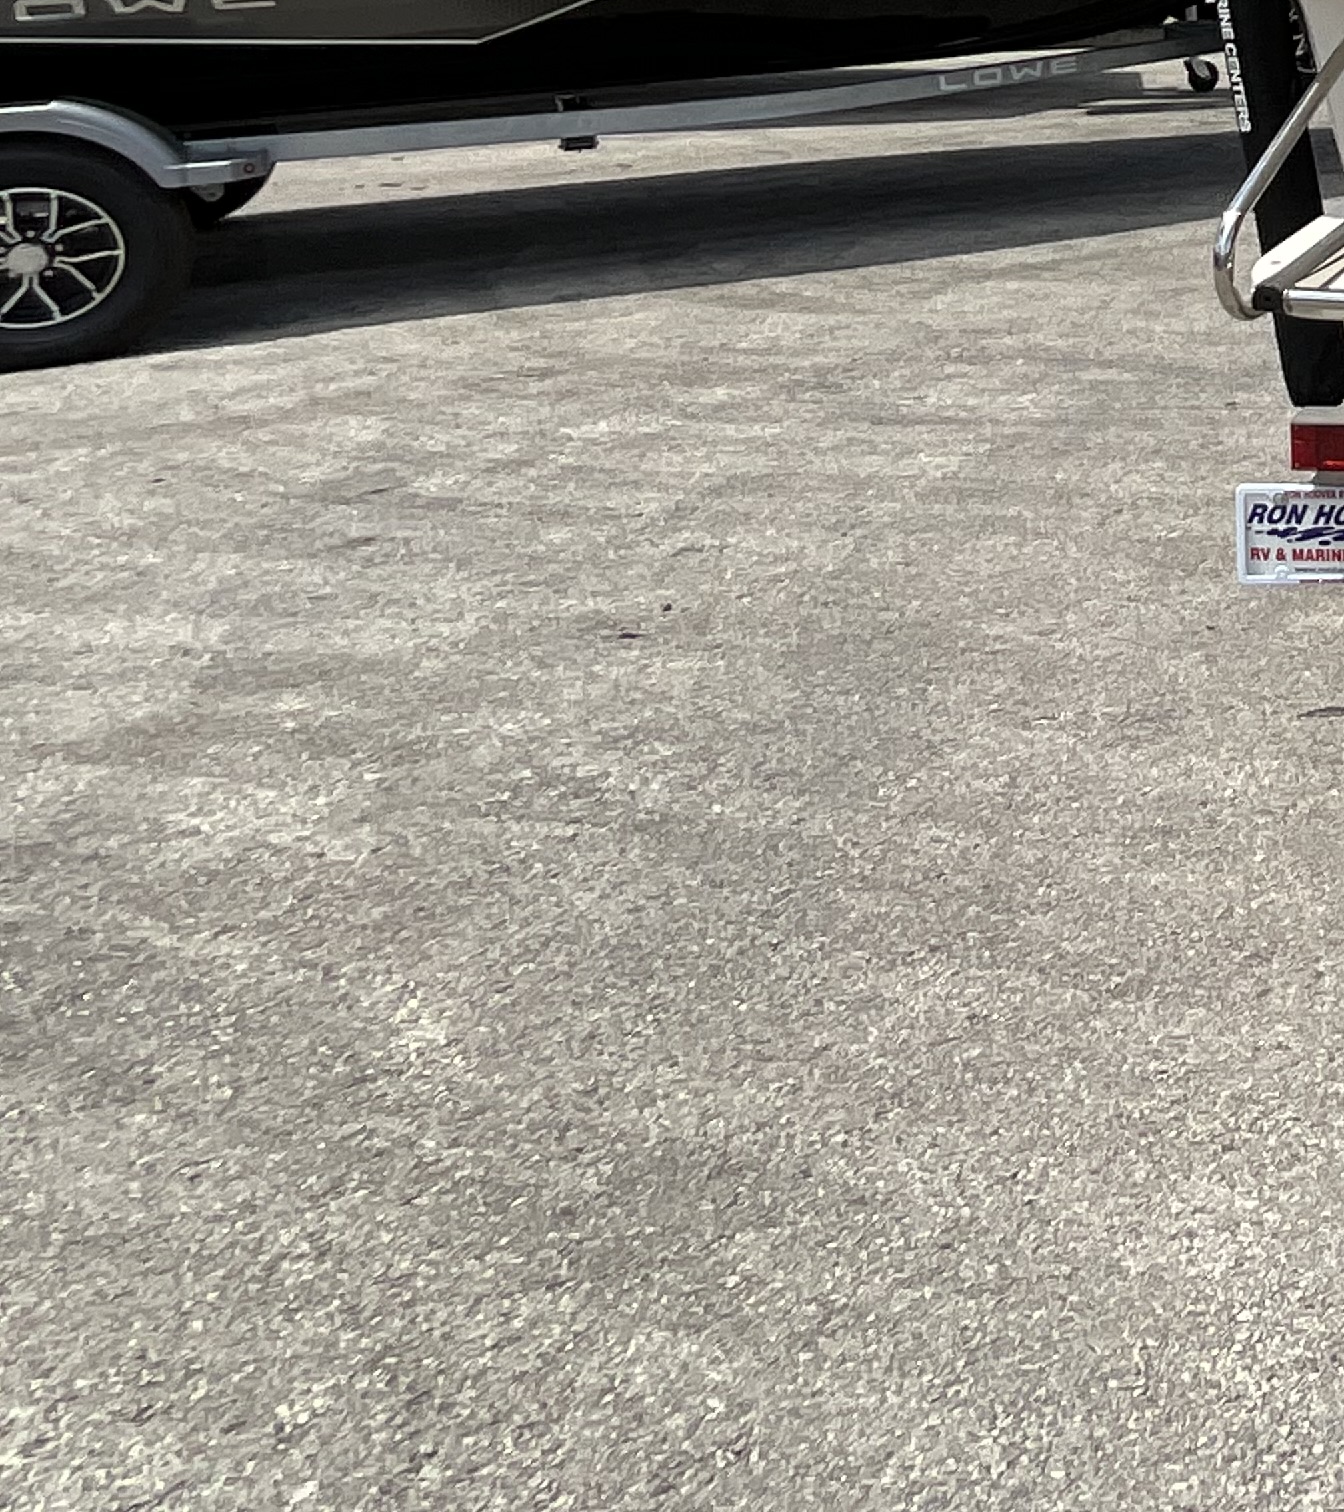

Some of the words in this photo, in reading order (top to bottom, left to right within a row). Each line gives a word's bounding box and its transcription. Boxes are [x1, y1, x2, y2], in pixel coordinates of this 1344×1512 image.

[938, 55, 1078, 91] LOWE
[1224, 42, 1253, 133] CENTERS
[1247, 503, 1309, 525] RON
[1250, 547, 1271, 561] RV
[1275, 547, 1287, 562] &
